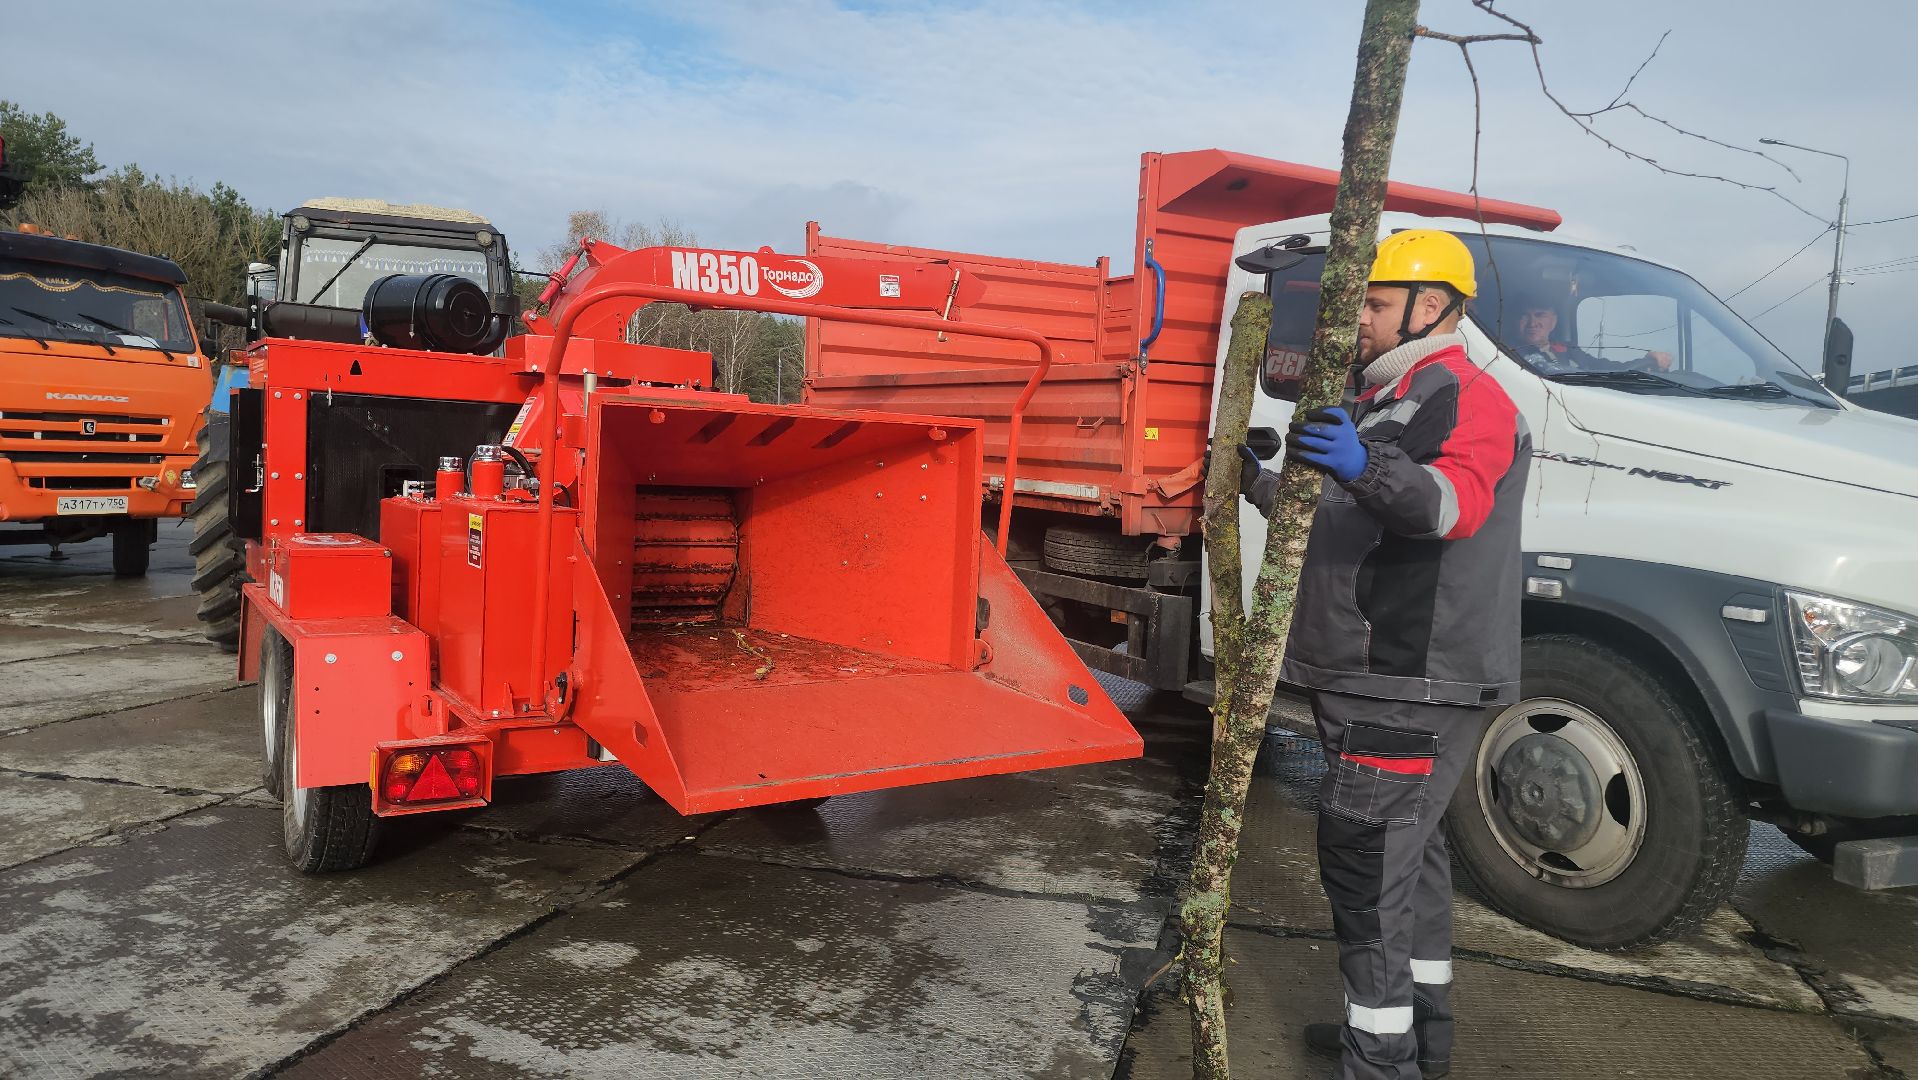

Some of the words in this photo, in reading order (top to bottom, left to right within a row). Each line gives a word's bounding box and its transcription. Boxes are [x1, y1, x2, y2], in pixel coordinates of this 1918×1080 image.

[671, 251, 759, 296] M350
[761, 266, 814, 284] Торнадо
[46, 392, 129, 403] KAMAZ
[1627, 467, 1734, 490] NEXT
